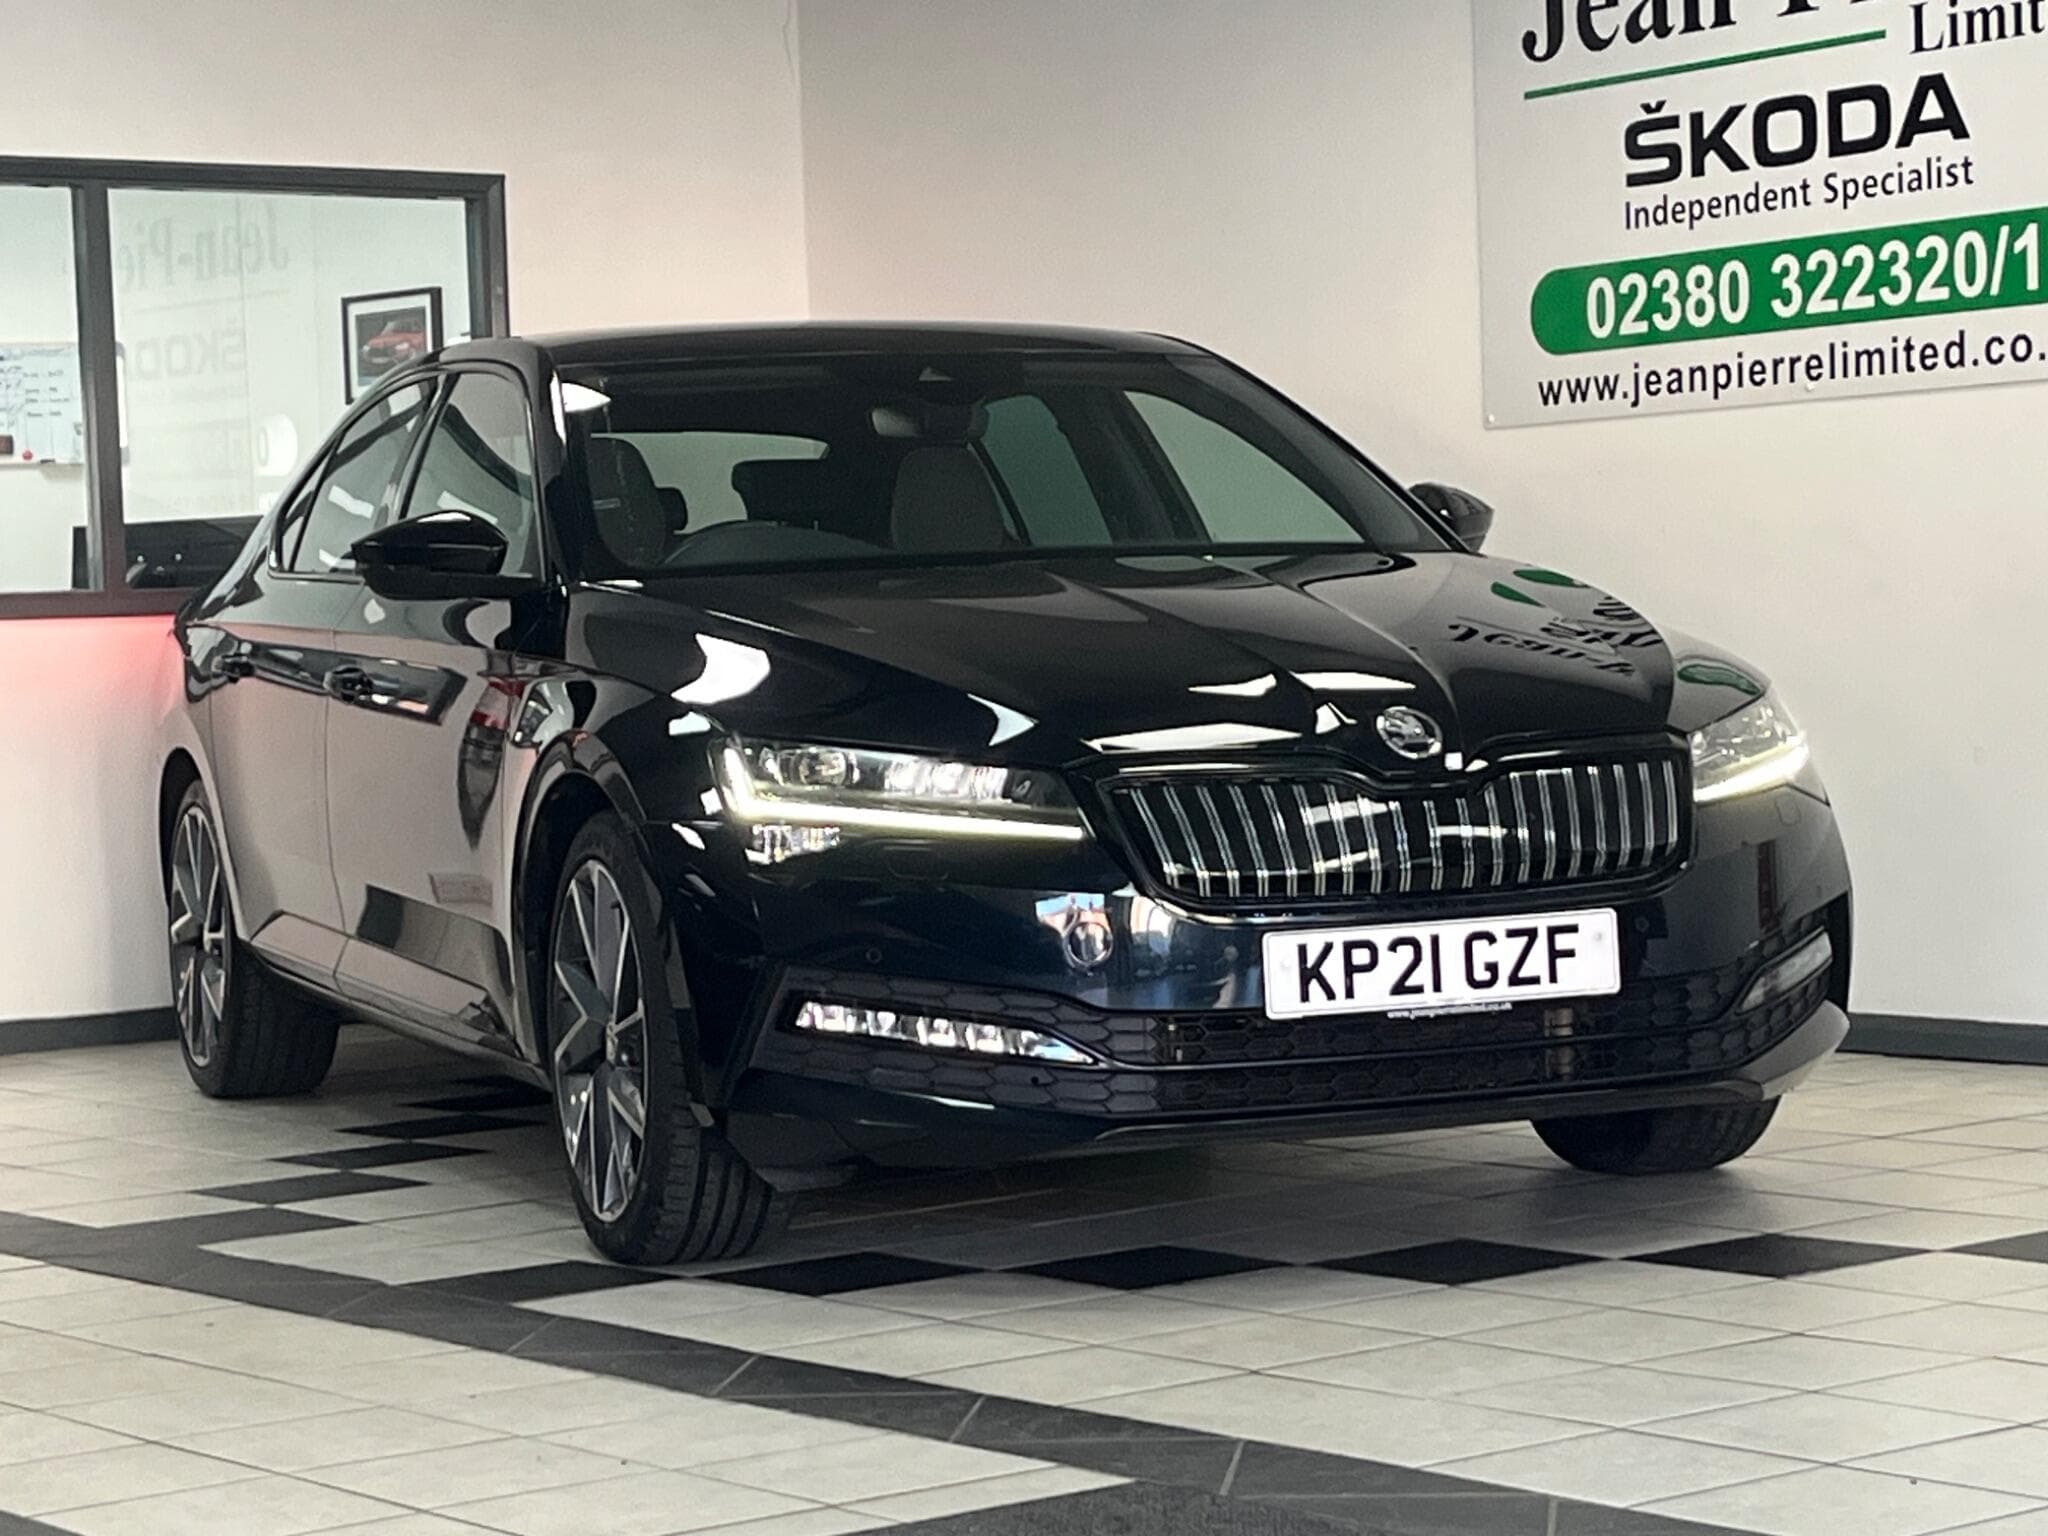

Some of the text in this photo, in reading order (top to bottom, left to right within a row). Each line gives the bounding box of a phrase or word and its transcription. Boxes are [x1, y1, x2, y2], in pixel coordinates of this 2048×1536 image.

[1624, 72, 1970, 187] ŠKODA
[1625, 156, 1974, 230] Independent Specialist
[1587, 222, 2039, 339] 02380 322320/1
[1538, 329, 2046, 408] www.jeanpierrelimited.co.
[1297, 923, 1579, 1003] KP21 GZF
